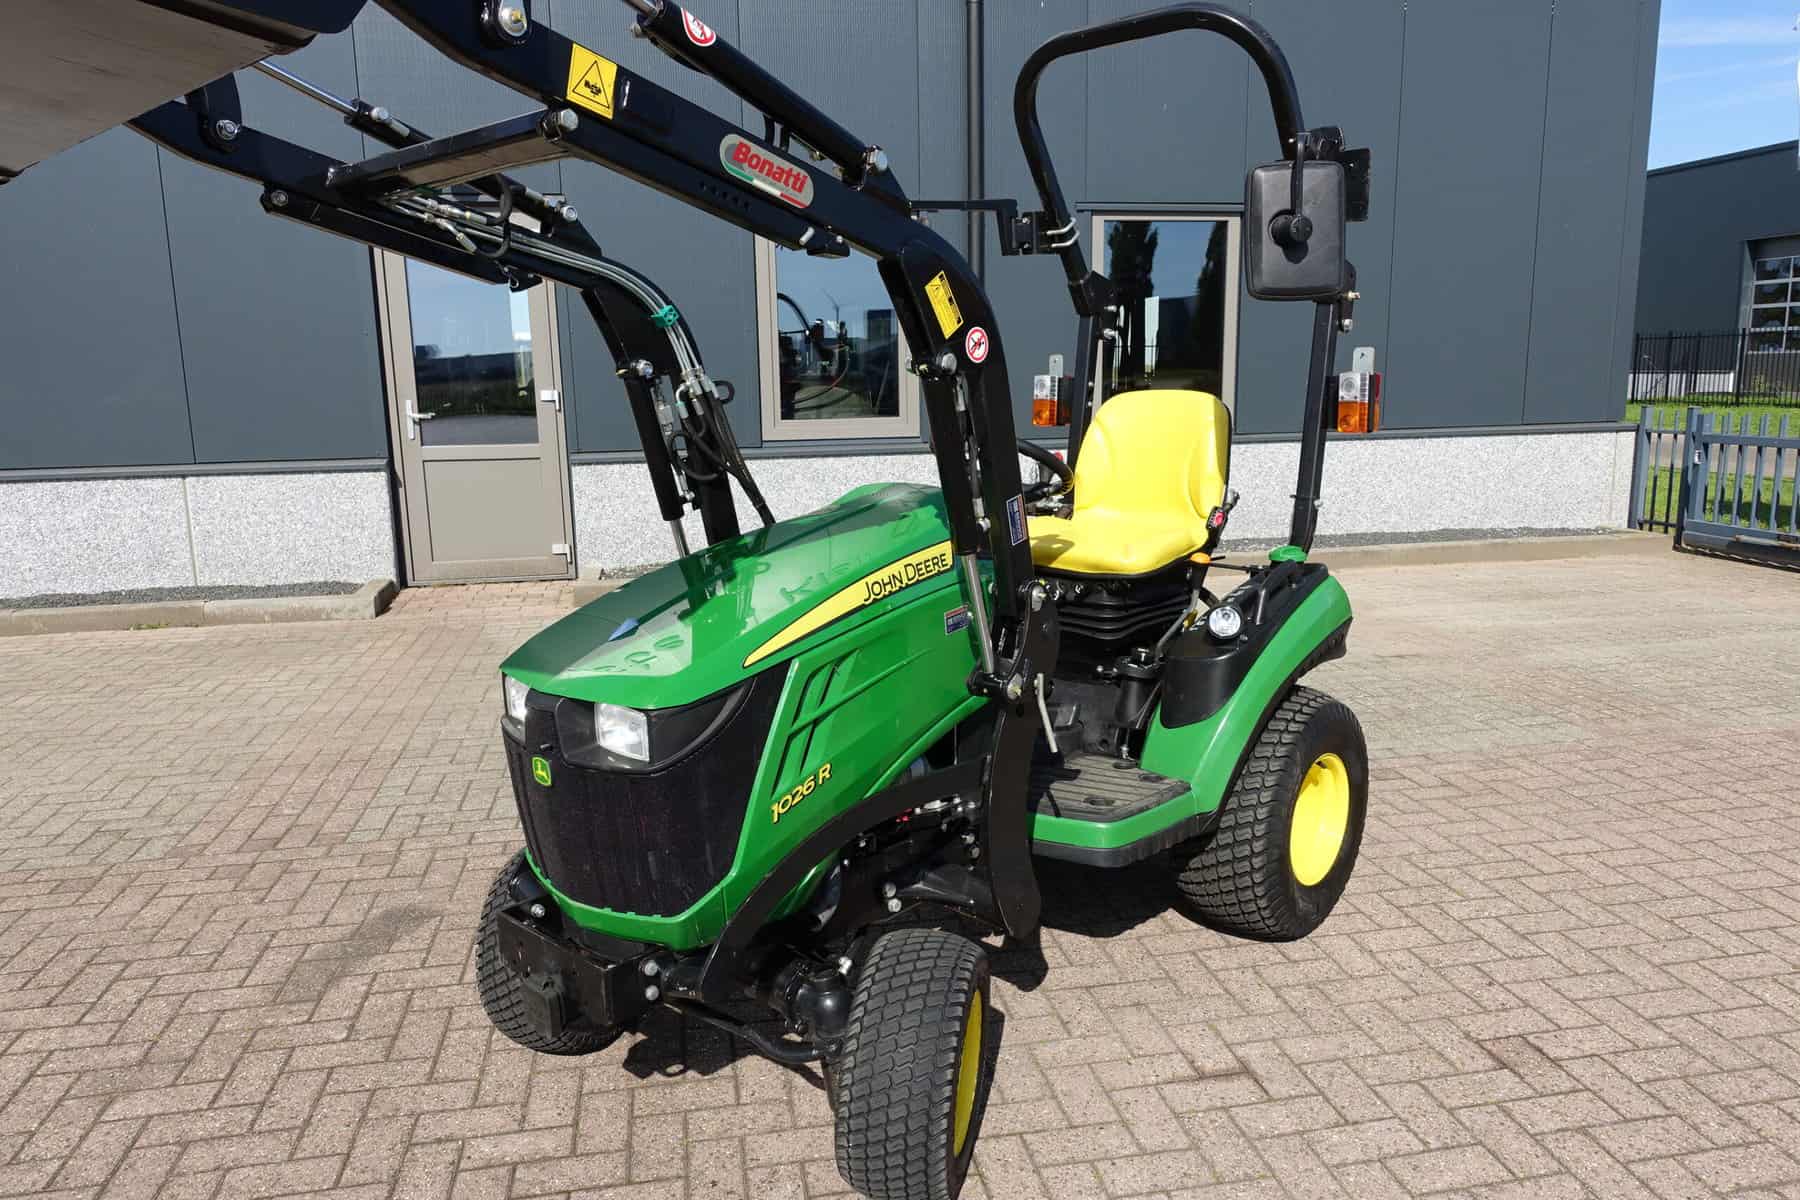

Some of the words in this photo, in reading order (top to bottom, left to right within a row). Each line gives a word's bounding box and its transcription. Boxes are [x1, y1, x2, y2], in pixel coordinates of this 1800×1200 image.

[732, 141, 809, 193] Bonatti
[863, 570, 904, 602] JOHN
[903, 552, 949, 583] DEERE
